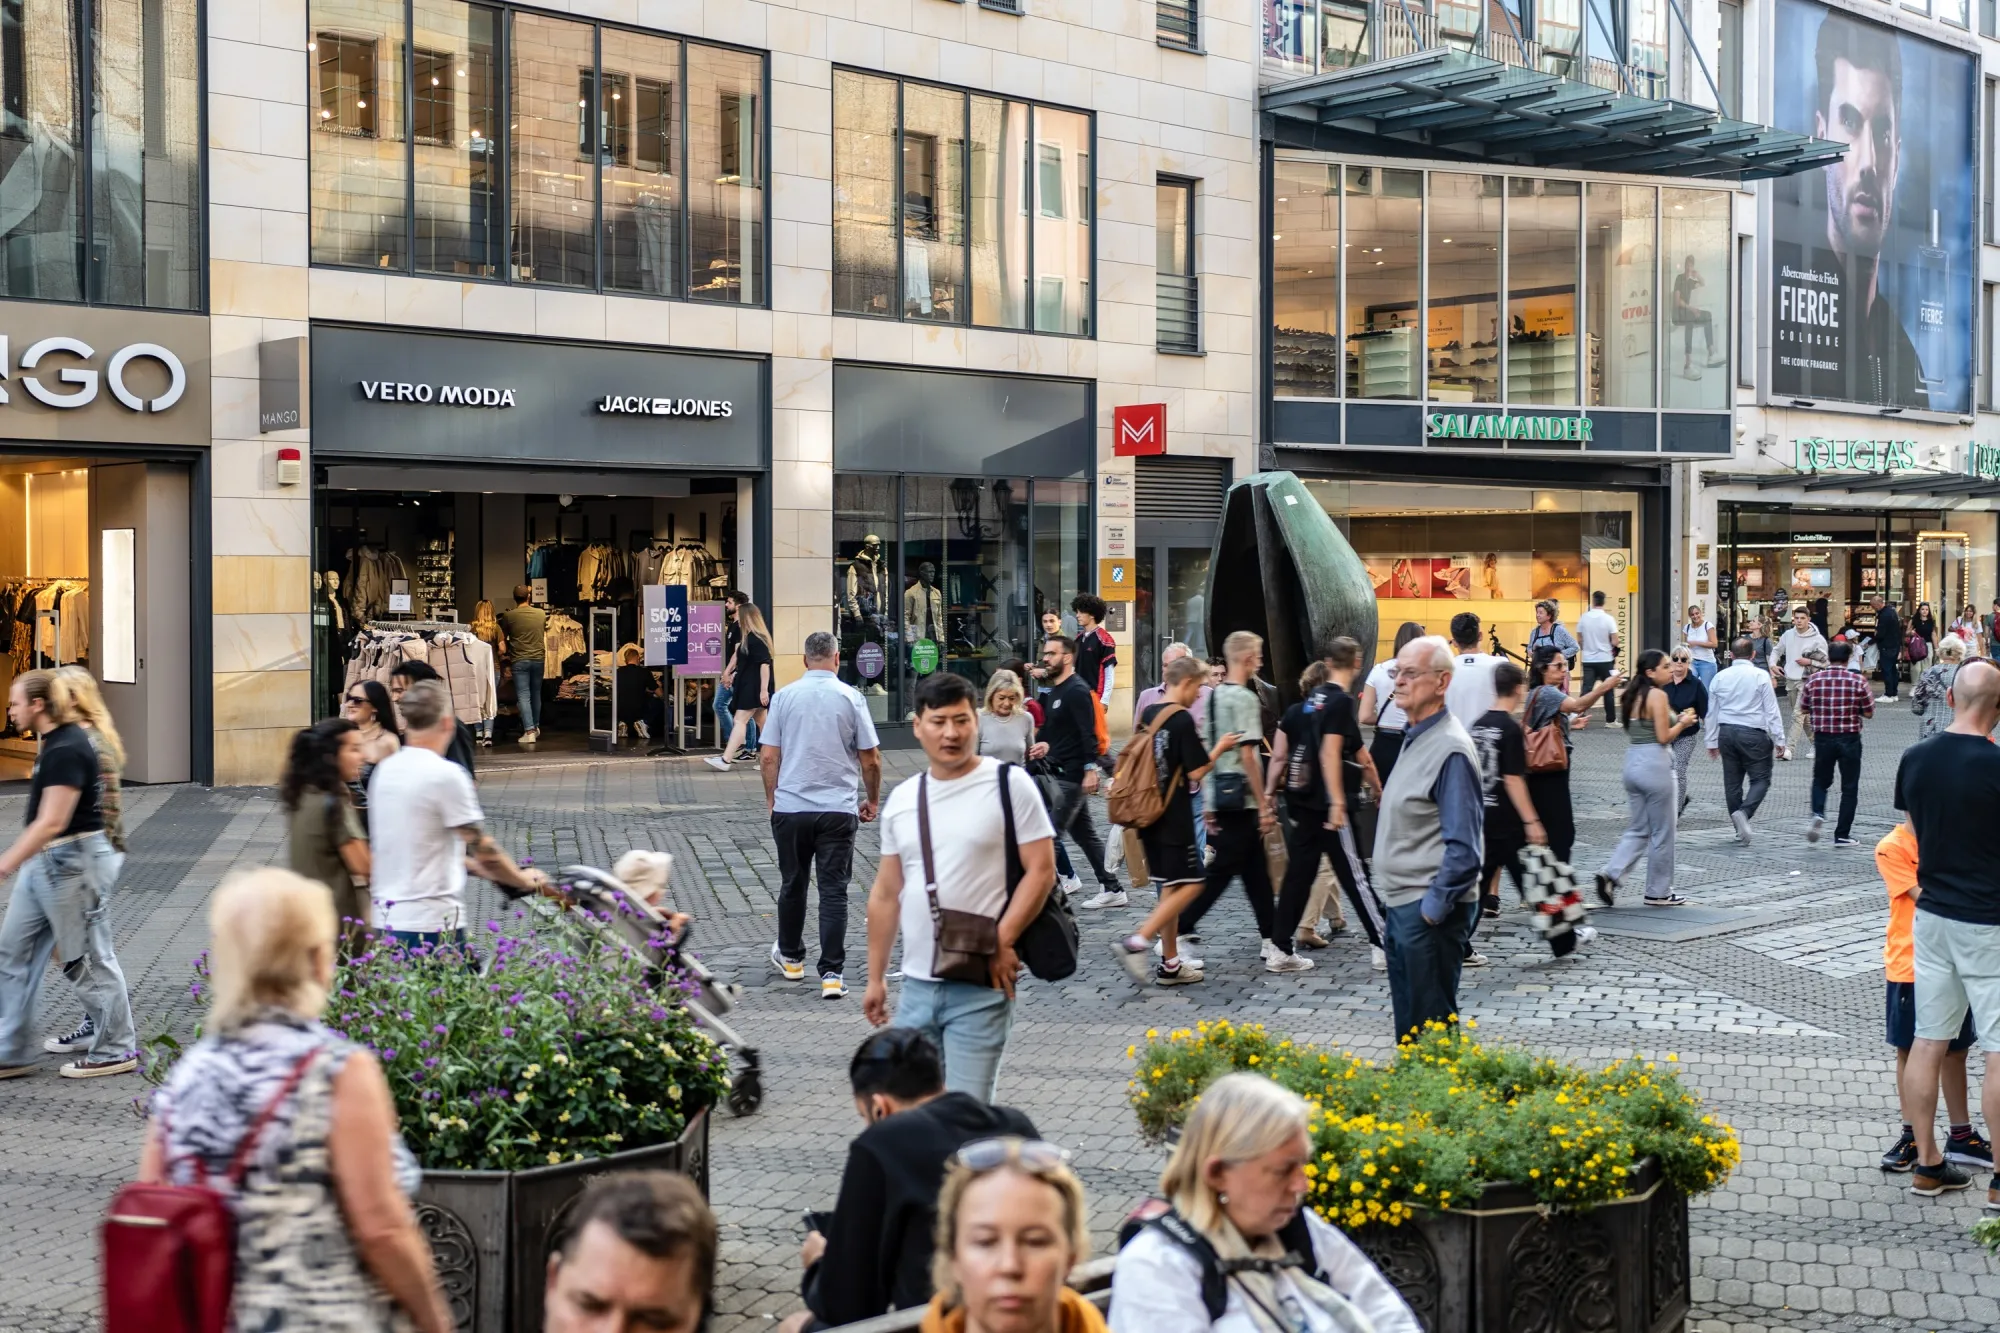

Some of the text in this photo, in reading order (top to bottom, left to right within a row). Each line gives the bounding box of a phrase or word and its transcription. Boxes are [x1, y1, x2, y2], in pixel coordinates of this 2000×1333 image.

[1781, 265, 1839, 286] Abercrombie & Fitch
[1780, 285, 1839, 328] FIERCE
[1920, 307, 1943, 325] FIERCE
[1780, 329, 1839, 348] COLOGNE
[0, 334, 187, 412] GO
[1781, 356, 1838, 371] THE ICONIC FRAGRANCE
[361, 380, 516, 407] VERO MODA
[599, 395, 733, 417] JACK JONES
[262, 410, 298, 425] MANGO
[1426, 413, 1593, 442] SALAMANDER
[1795, 438, 1918, 471] DOUGLAS
[1697, 563, 1709, 577] 25
[650, 607, 681, 623] 50%
[1618, 596, 1627, 672] SALAMANDER
